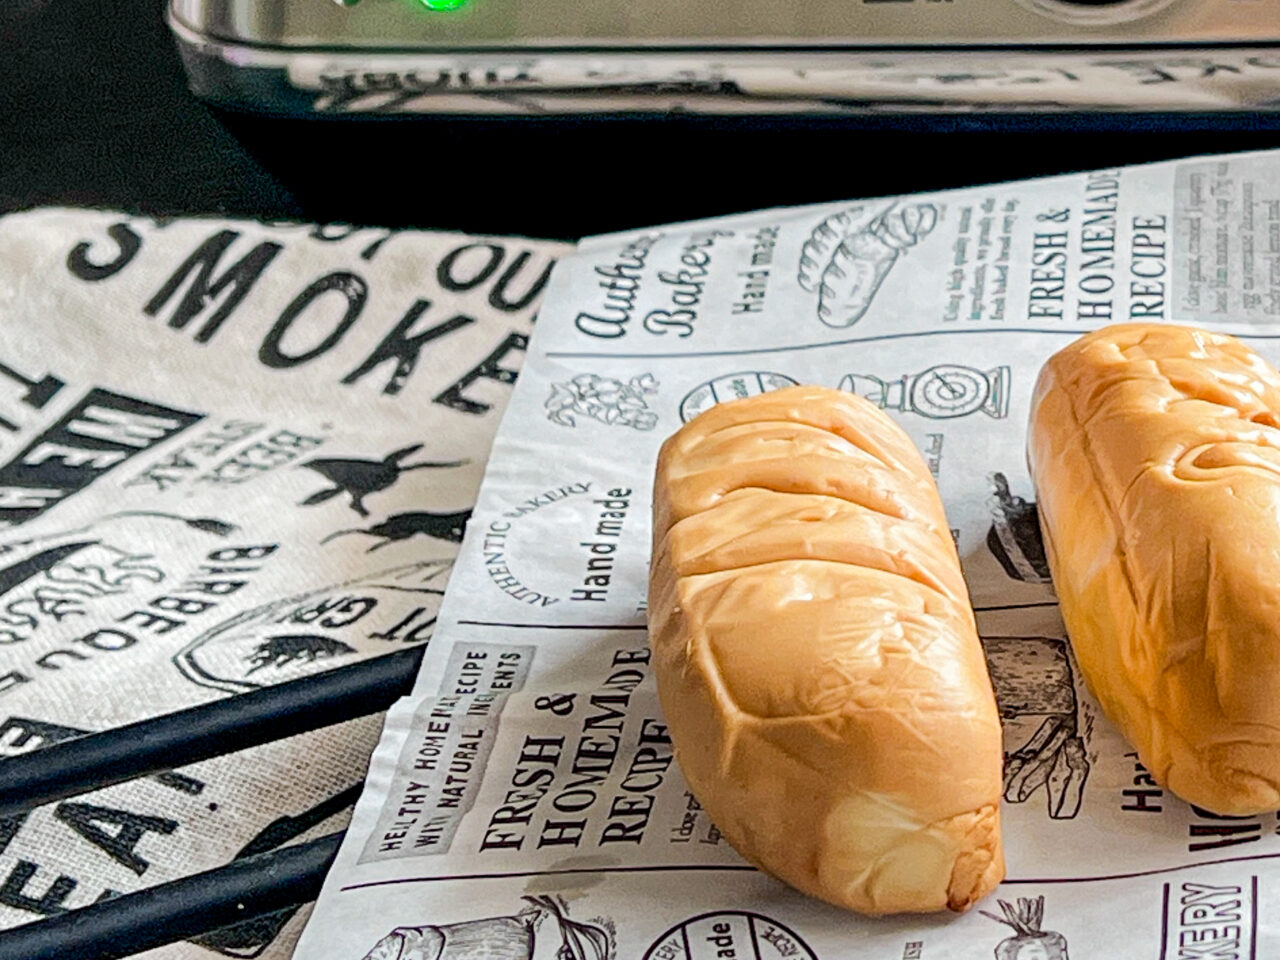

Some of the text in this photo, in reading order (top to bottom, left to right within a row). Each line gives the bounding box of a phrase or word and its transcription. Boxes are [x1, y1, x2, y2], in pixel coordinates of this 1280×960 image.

[731, 271, 769, 314] Hand
[1027, 208, 1071, 320] FRESH &
[1076, 170, 1121, 320] HOMEMADE
[1128, 215, 1166, 320] RECIPE
[67, 222, 530, 415] SMOKE
[483, 521, 559, 608] AUTHENTIC
[570, 487, 633, 602] Hand made
[455, 651, 487, 695] ECIPE
[436, 729, 483, 808] NATURAL
[479, 692, 577, 854] FRESH &
[536, 647, 651, 851] HOMEMADE
[705, 922, 738, 960] ade
